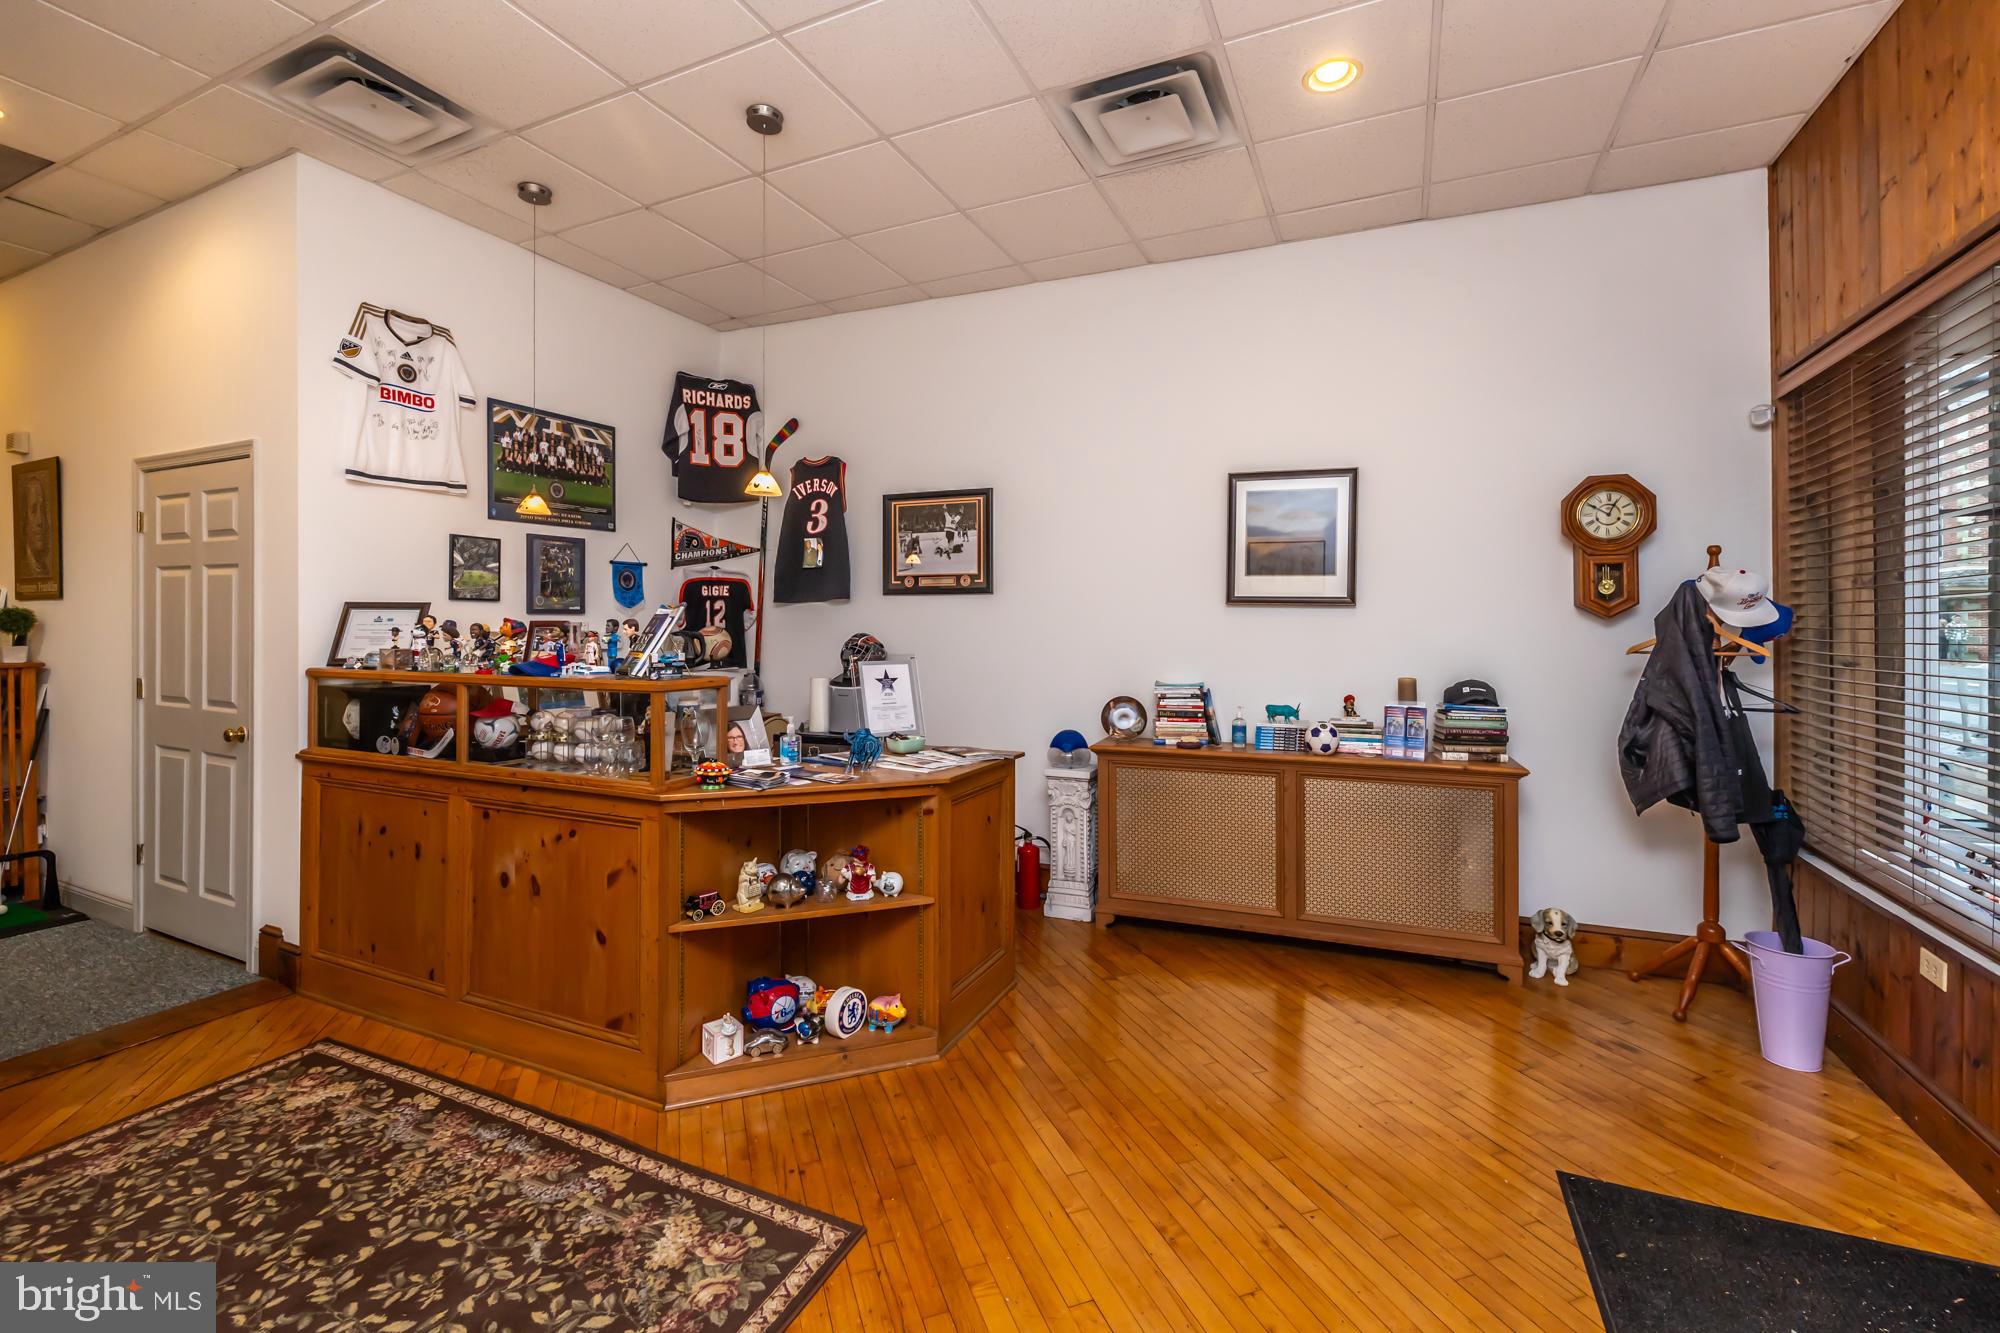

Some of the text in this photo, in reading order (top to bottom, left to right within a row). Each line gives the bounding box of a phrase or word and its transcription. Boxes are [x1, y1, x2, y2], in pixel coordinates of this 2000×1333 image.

[380, 386, 435, 410] BIMBO
[682, 388, 752, 410] RICHARDS
[689, 408, 746, 468] 18
[806, 498, 829, 534] 3
[675, 546, 728, 560] CHAMPIONS
[705, 600, 726, 629] 12
